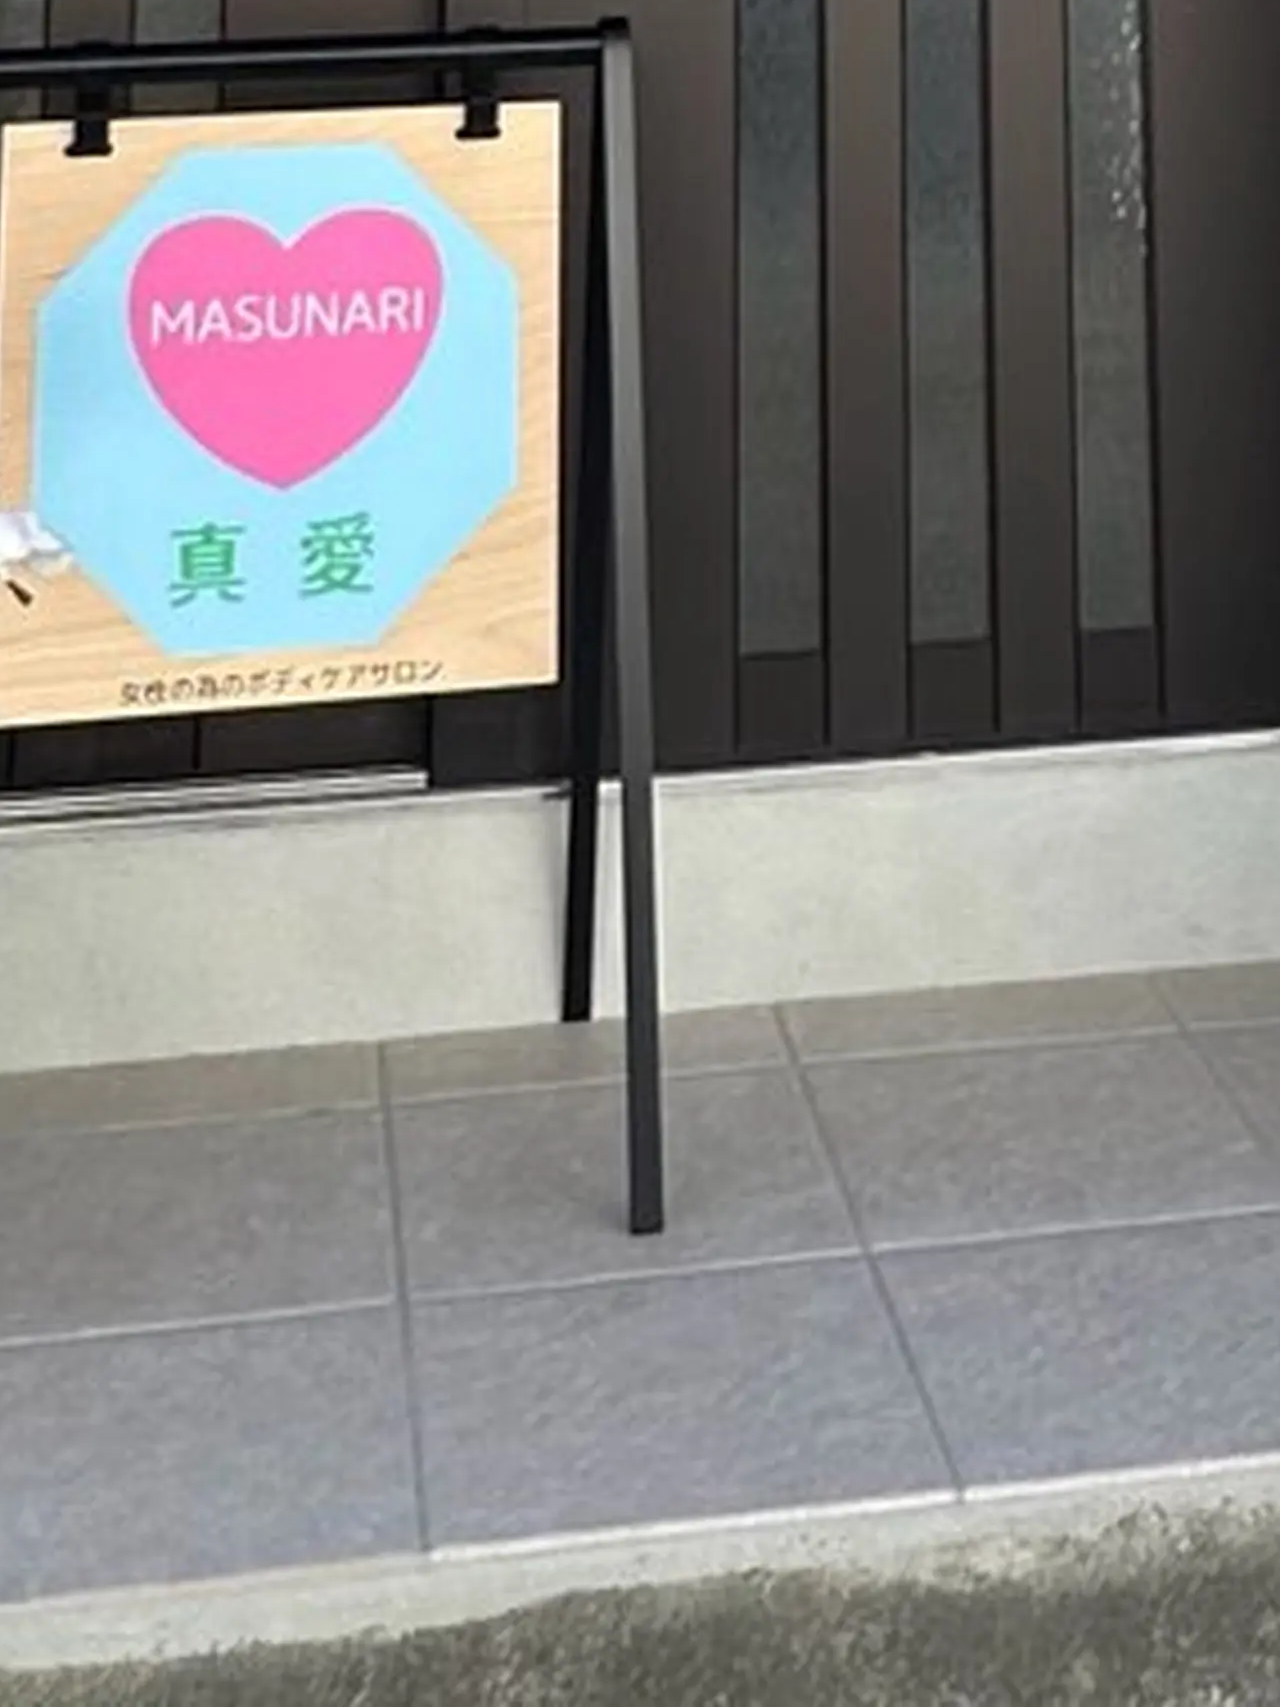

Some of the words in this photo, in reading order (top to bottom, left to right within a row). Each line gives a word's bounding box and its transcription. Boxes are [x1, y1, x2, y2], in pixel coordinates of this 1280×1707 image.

[150, 286, 426, 349] MASUNARI
[120, 660, 444, 706] 女性の為のボディケアサロン
